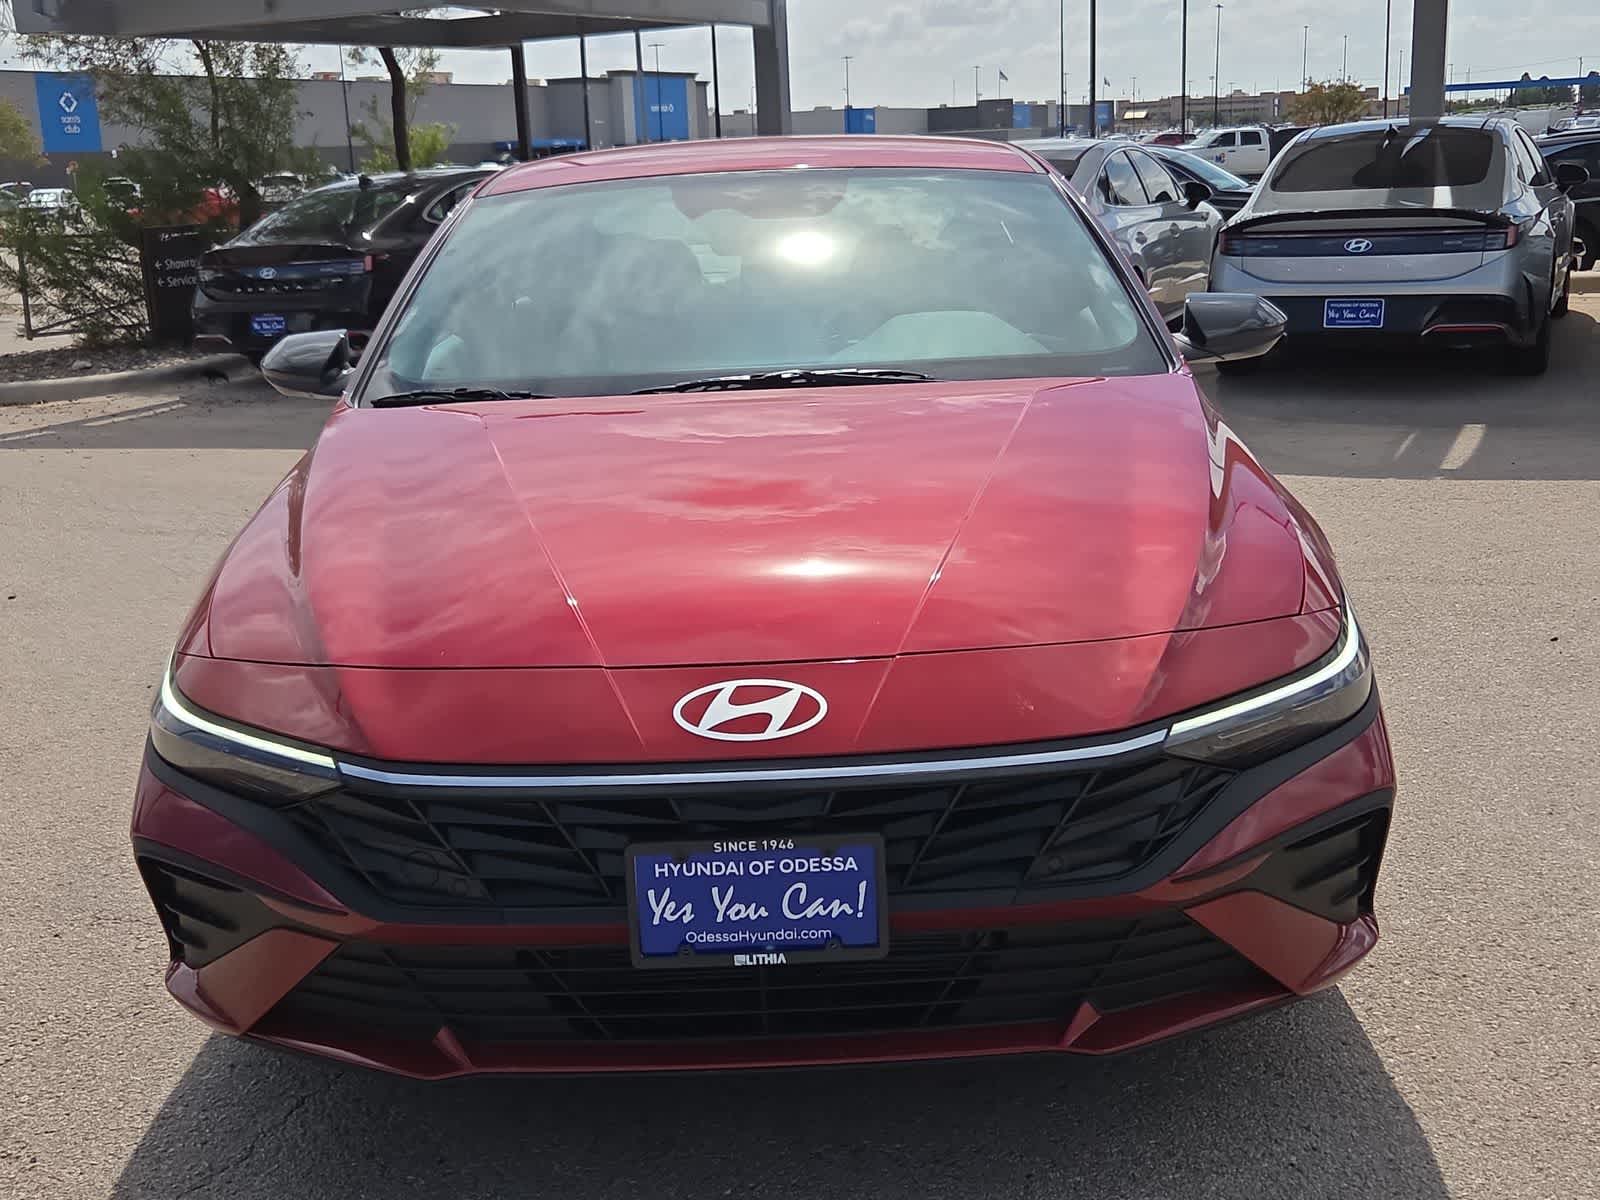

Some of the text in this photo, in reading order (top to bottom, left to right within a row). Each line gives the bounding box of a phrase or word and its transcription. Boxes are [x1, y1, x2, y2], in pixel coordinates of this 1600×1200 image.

[1343, 308, 1356, 319] You
[713, 839, 795, 853] SINCE 1946
[654, 856, 858, 878] HYUNDAI OF ODESSA
[647, 880, 868, 926] Yes You Can!
[685, 927, 832, 945] OdessaHyundai.com
[745, 953, 787, 966] LITHIA
